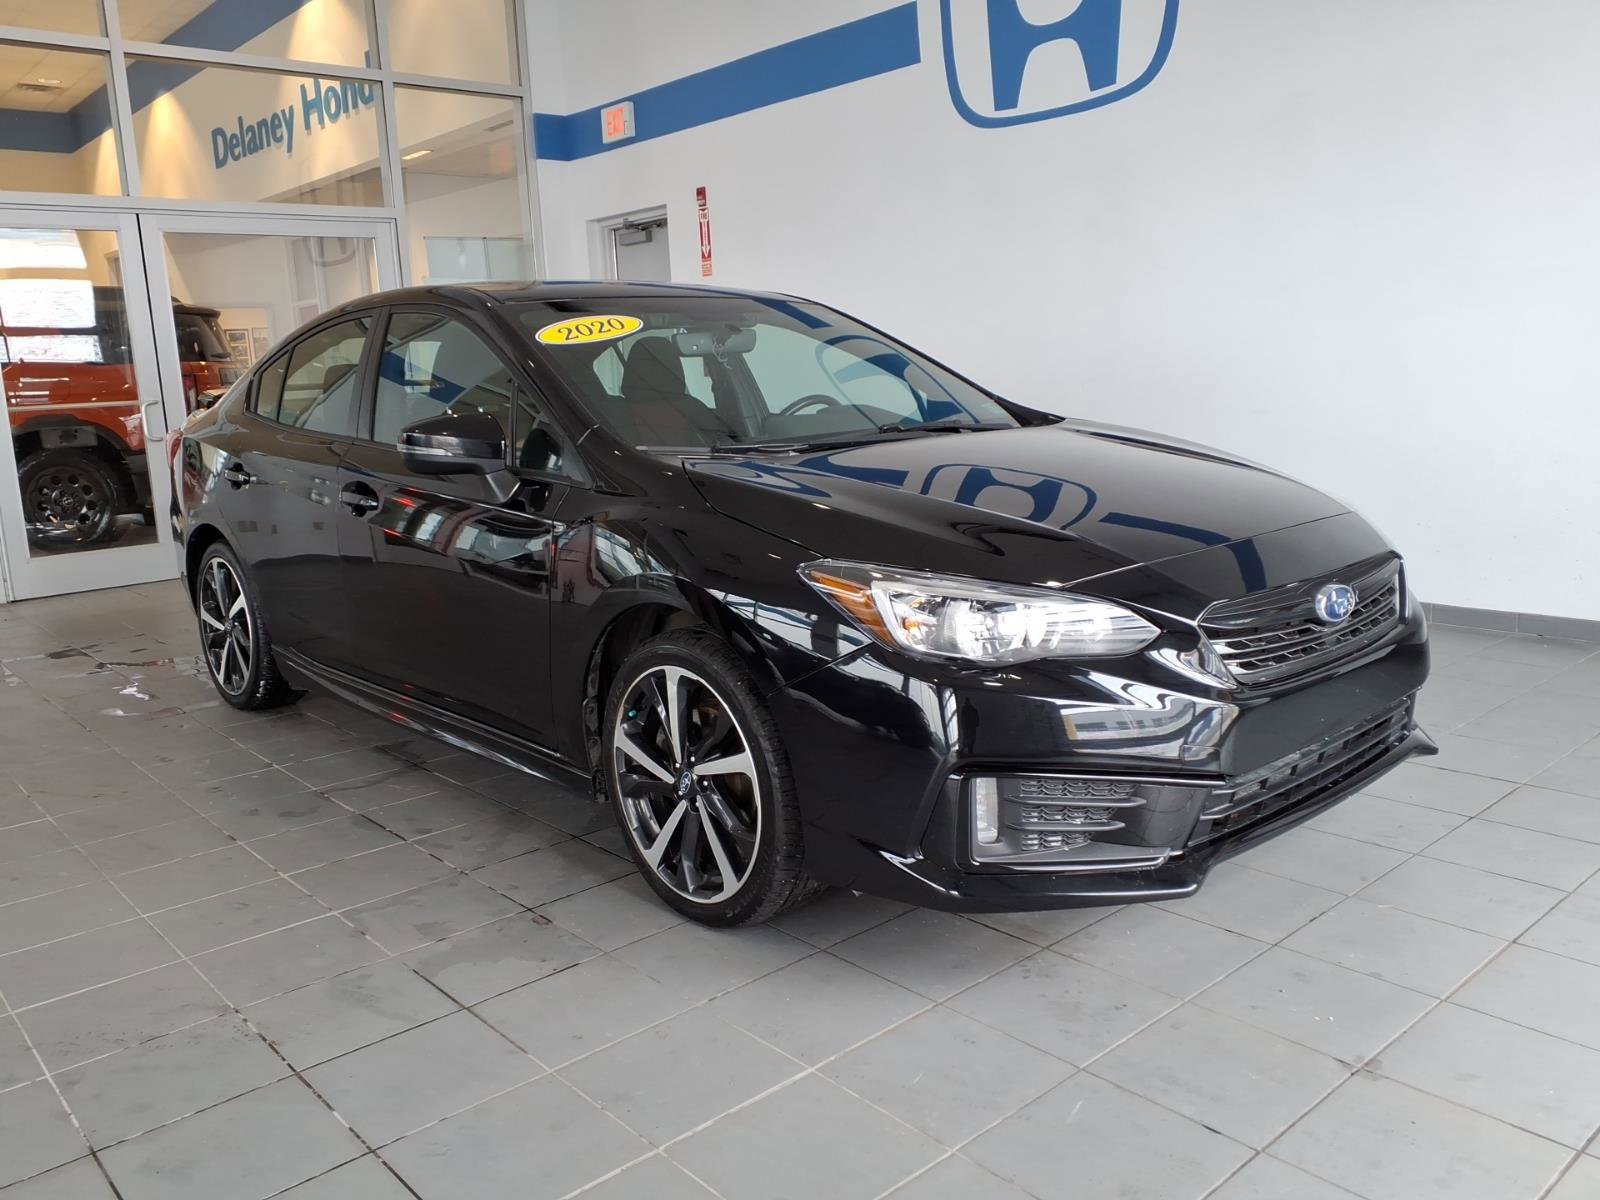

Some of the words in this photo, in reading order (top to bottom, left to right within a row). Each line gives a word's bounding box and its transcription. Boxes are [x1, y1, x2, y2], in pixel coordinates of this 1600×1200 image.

[211, 105, 295, 169] Delaney
[300, 51, 374, 131] Hond
[558, 318, 625, 341] 2020
